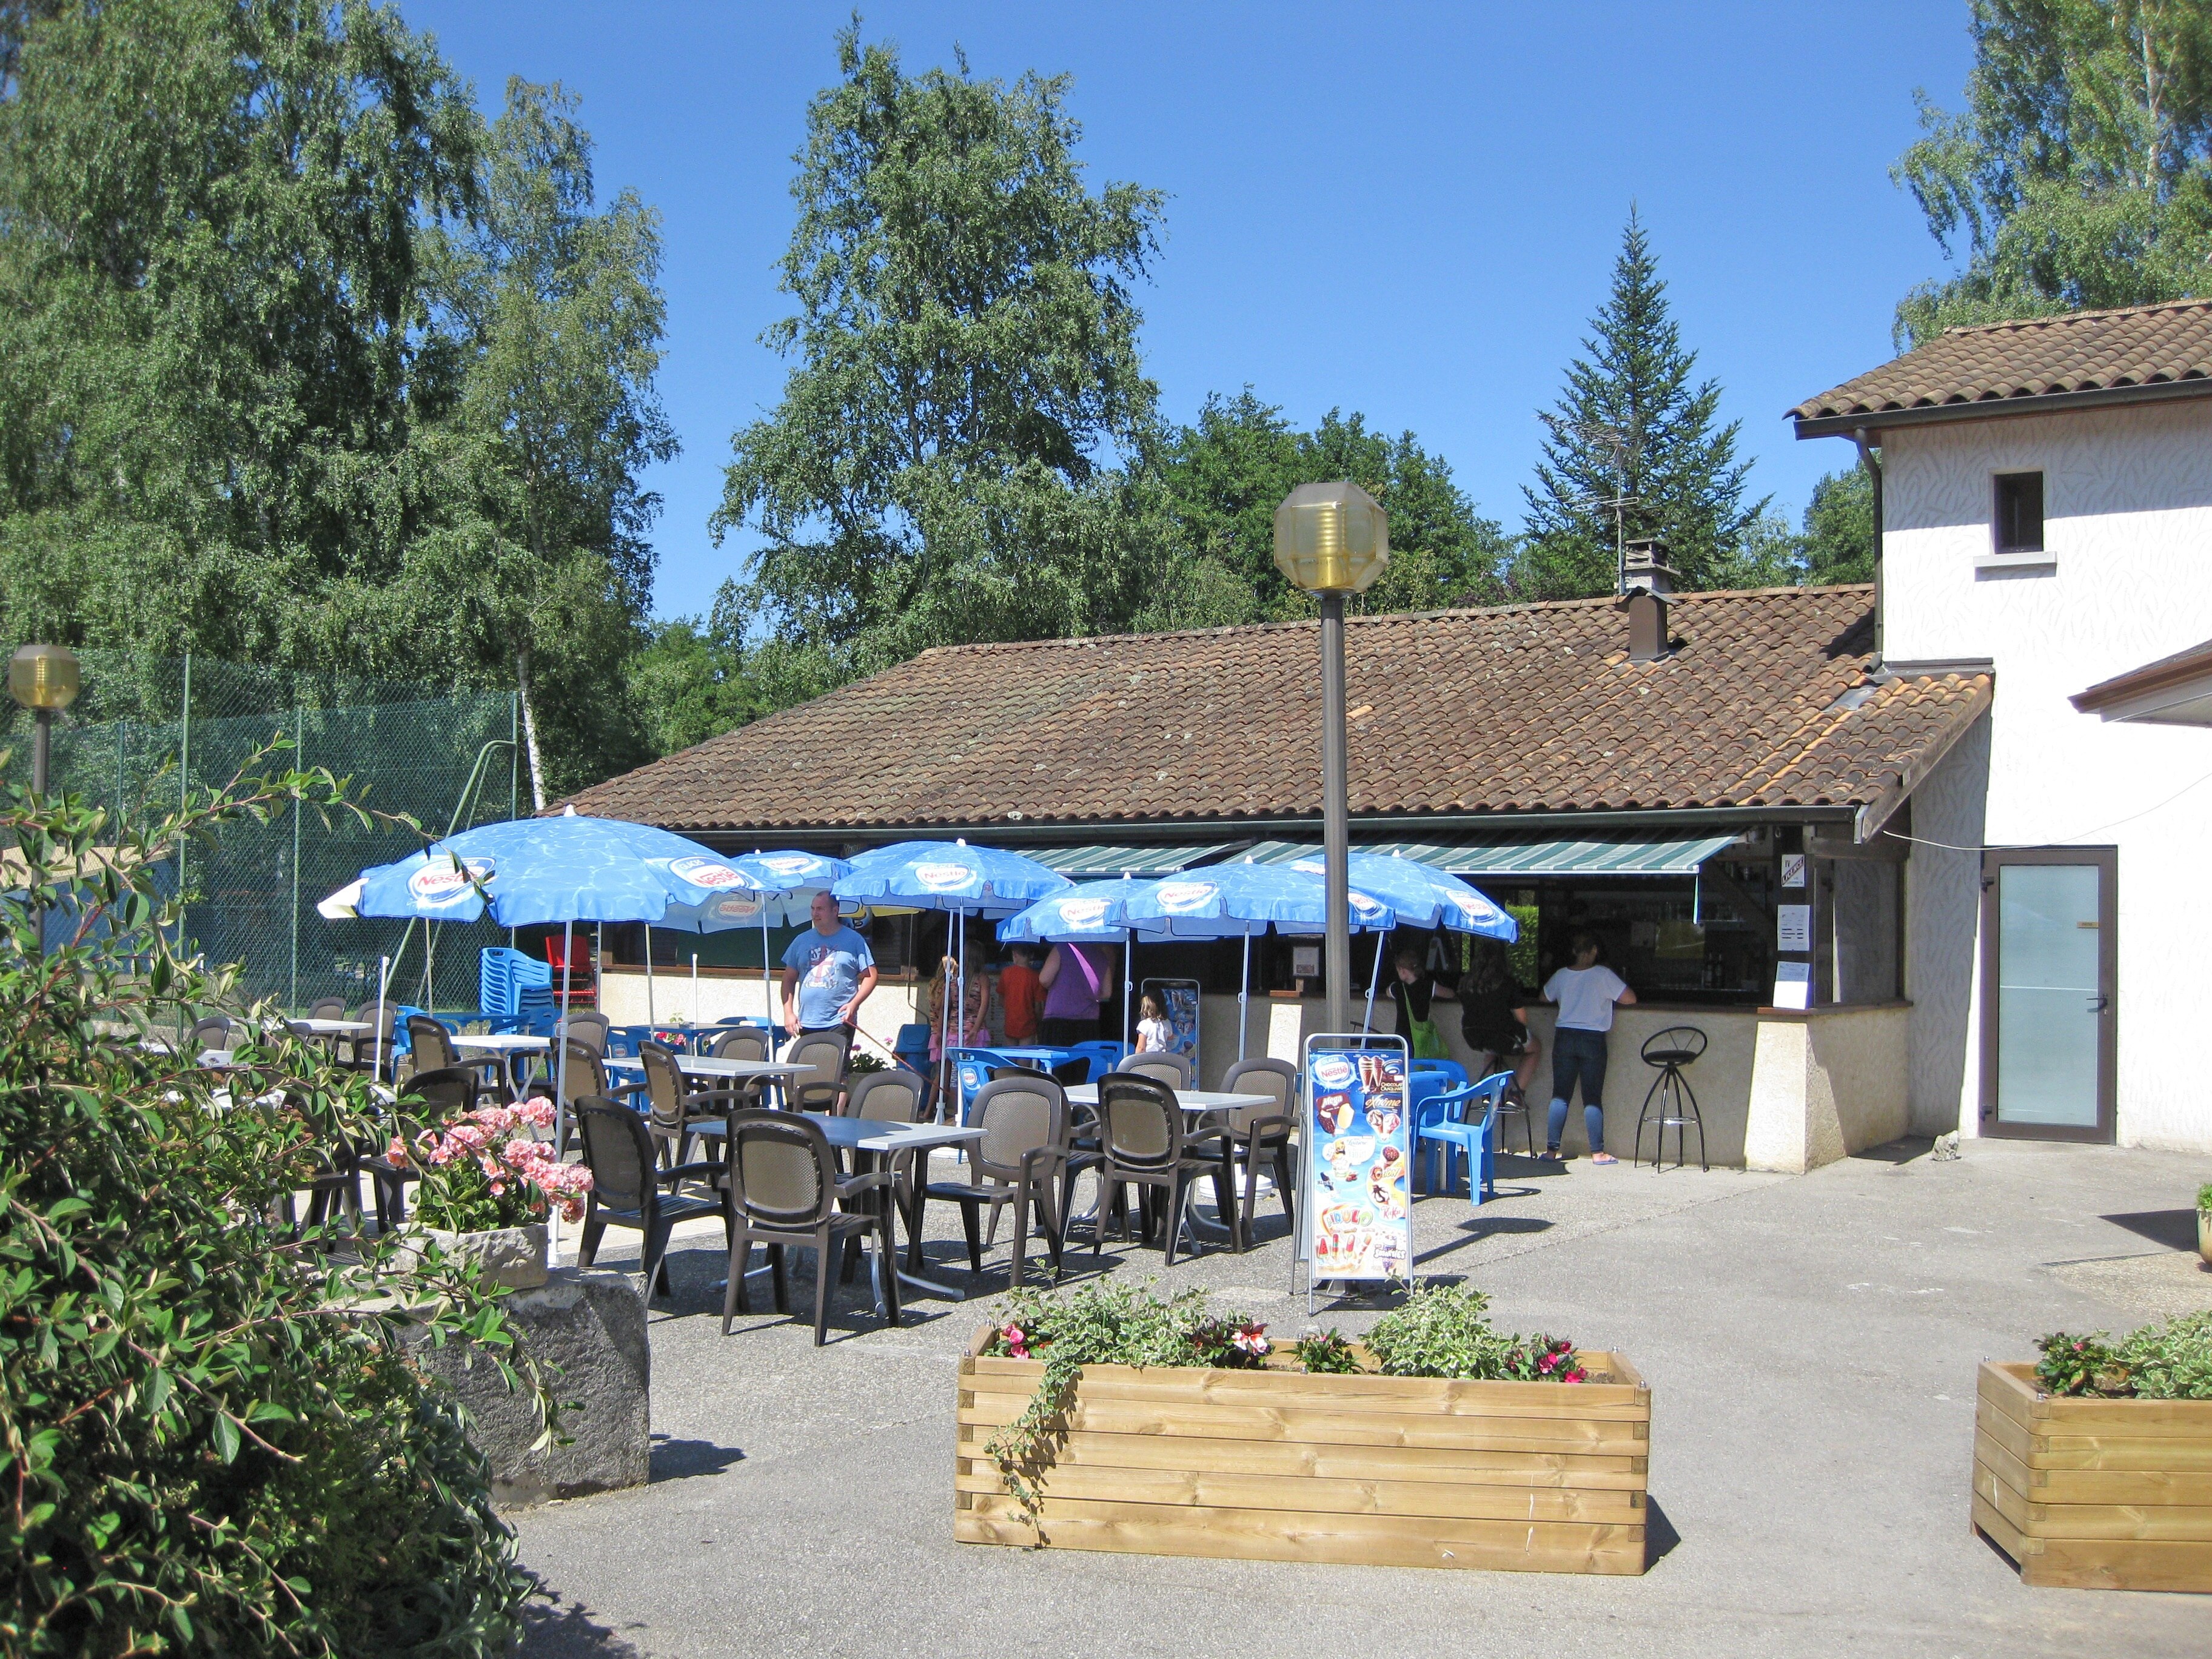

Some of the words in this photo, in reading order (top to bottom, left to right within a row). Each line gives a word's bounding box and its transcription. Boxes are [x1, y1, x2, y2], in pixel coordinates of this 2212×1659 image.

[694, 868, 739, 887] Nestlé
[1321, 1065, 1347, 1078] Nestlé
[1321, 1095, 1344, 1108] Mega
